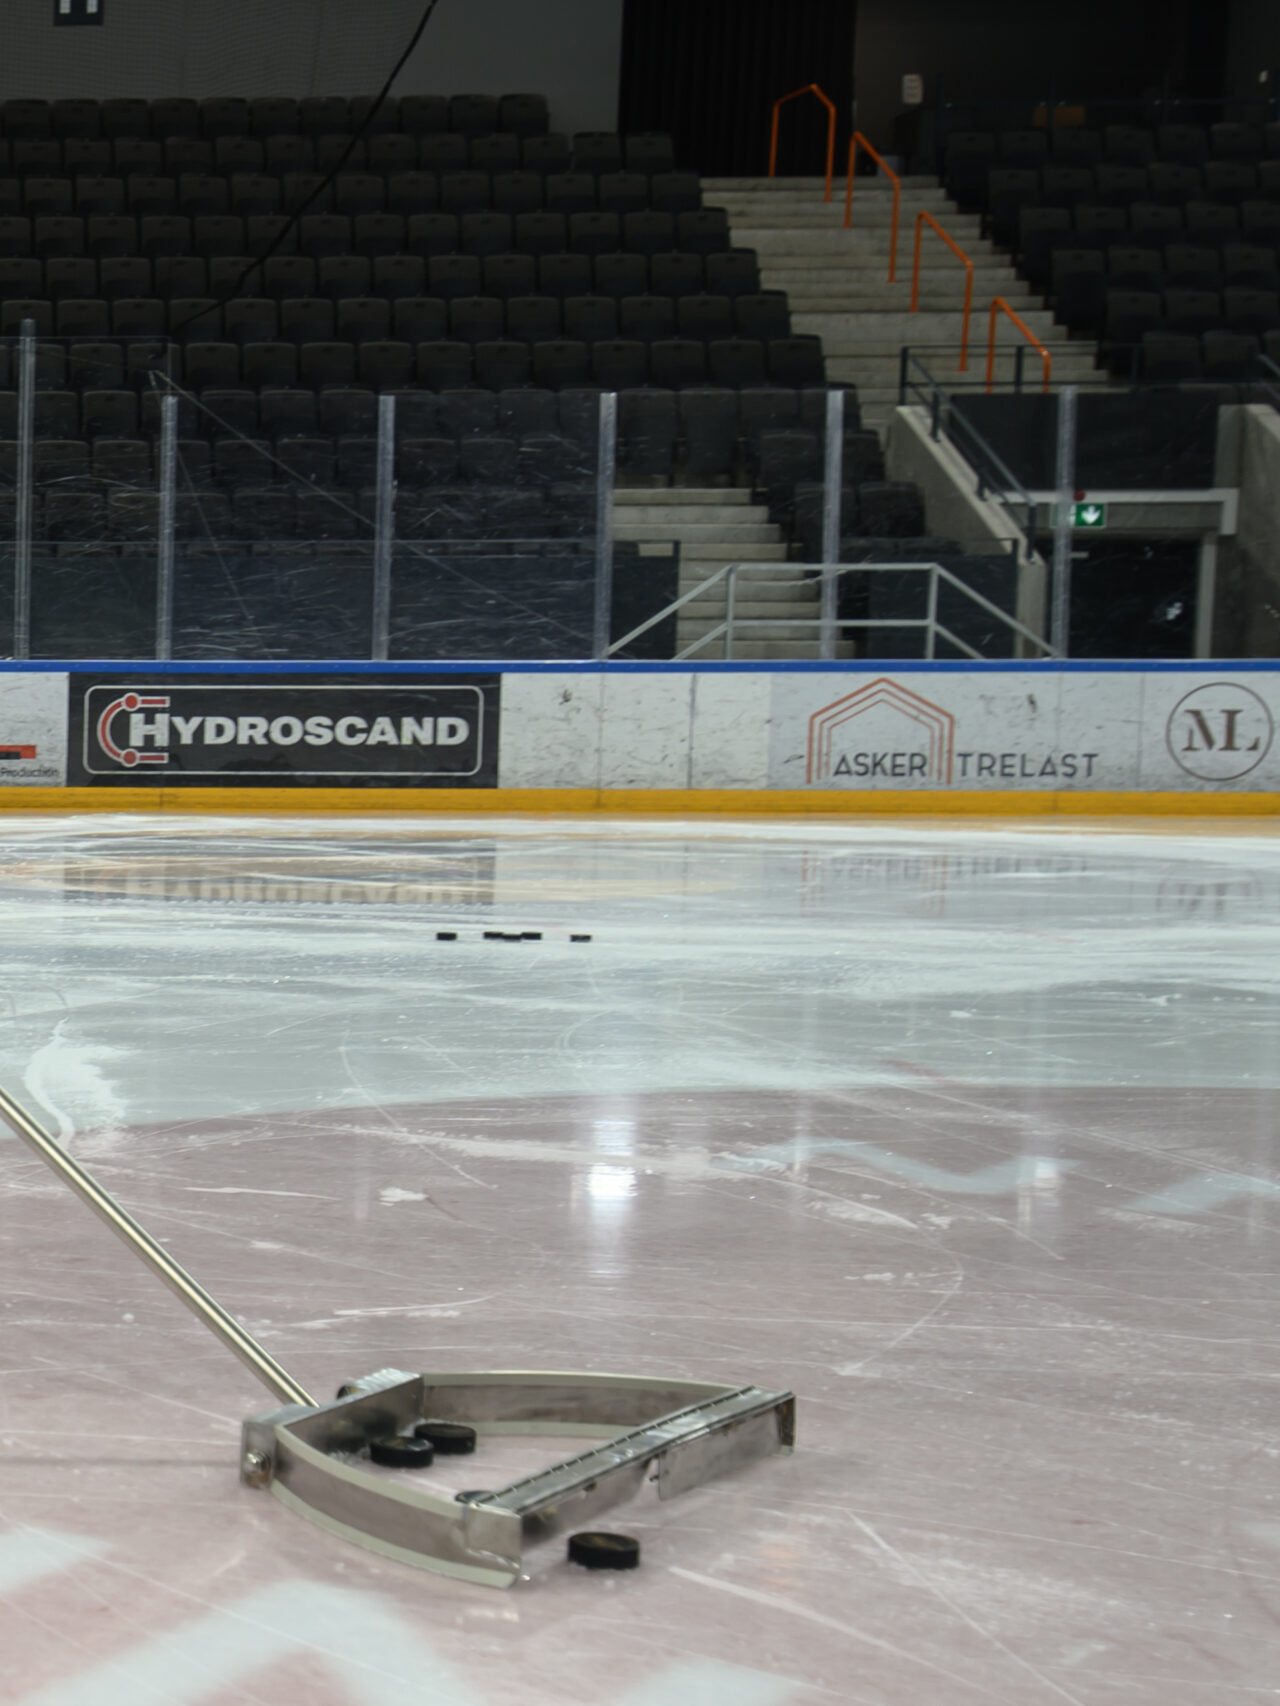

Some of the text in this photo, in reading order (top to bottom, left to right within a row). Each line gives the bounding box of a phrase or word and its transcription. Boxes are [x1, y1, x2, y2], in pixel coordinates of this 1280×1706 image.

[129, 712, 470, 747] HYDROSCAND
[833, 752, 1099, 778] ASKER TRELAST
